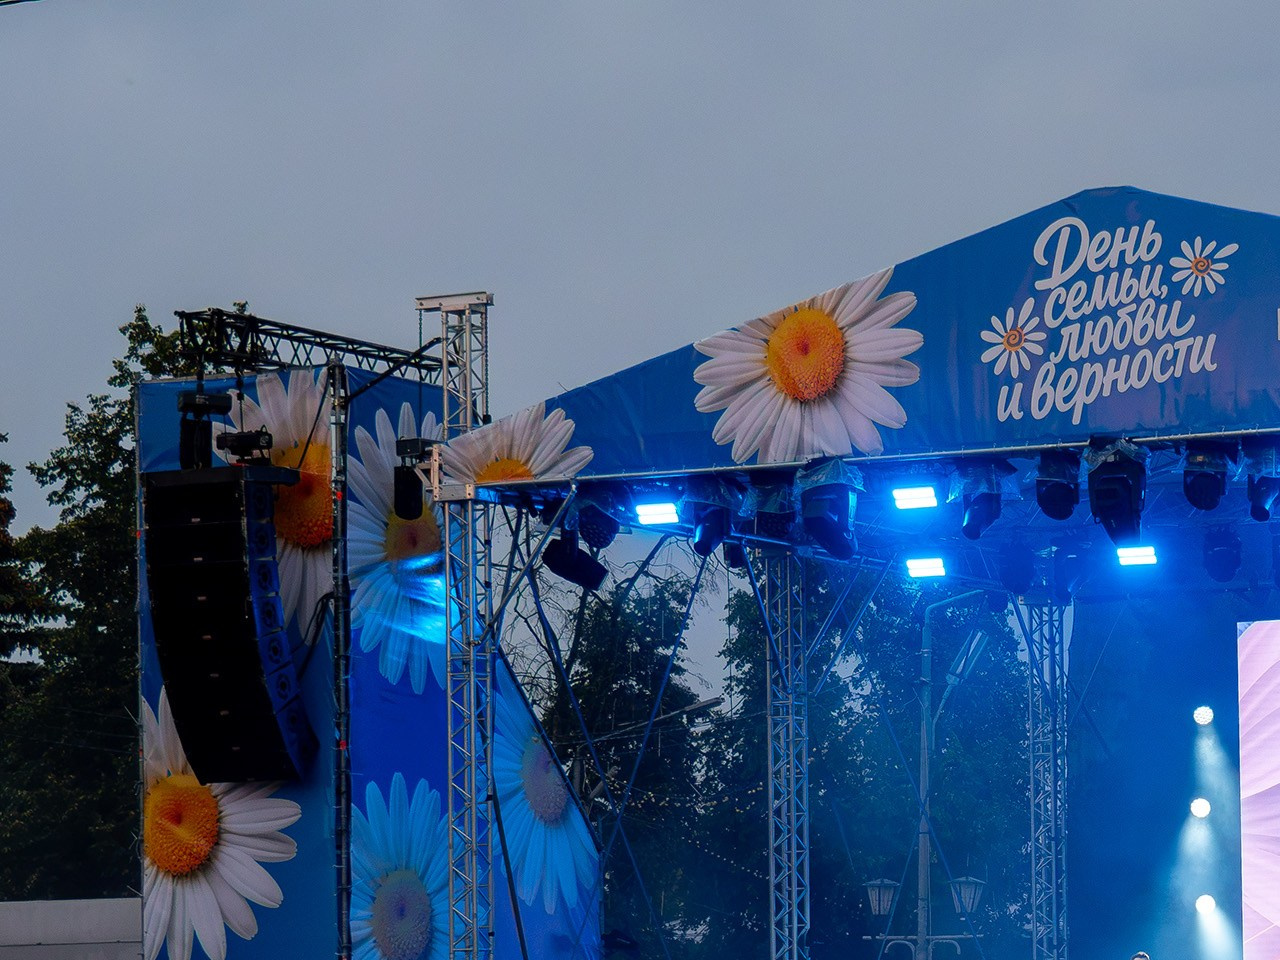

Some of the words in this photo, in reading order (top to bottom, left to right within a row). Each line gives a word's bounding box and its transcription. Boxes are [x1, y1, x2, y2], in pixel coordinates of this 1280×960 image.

[1033, 216, 1163, 291] День
[1043, 264, 1169, 329] семьи,
[1049, 298, 1196, 365] любви
[997, 380, 1024, 423] и
[1031, 333, 1218, 426] верности
